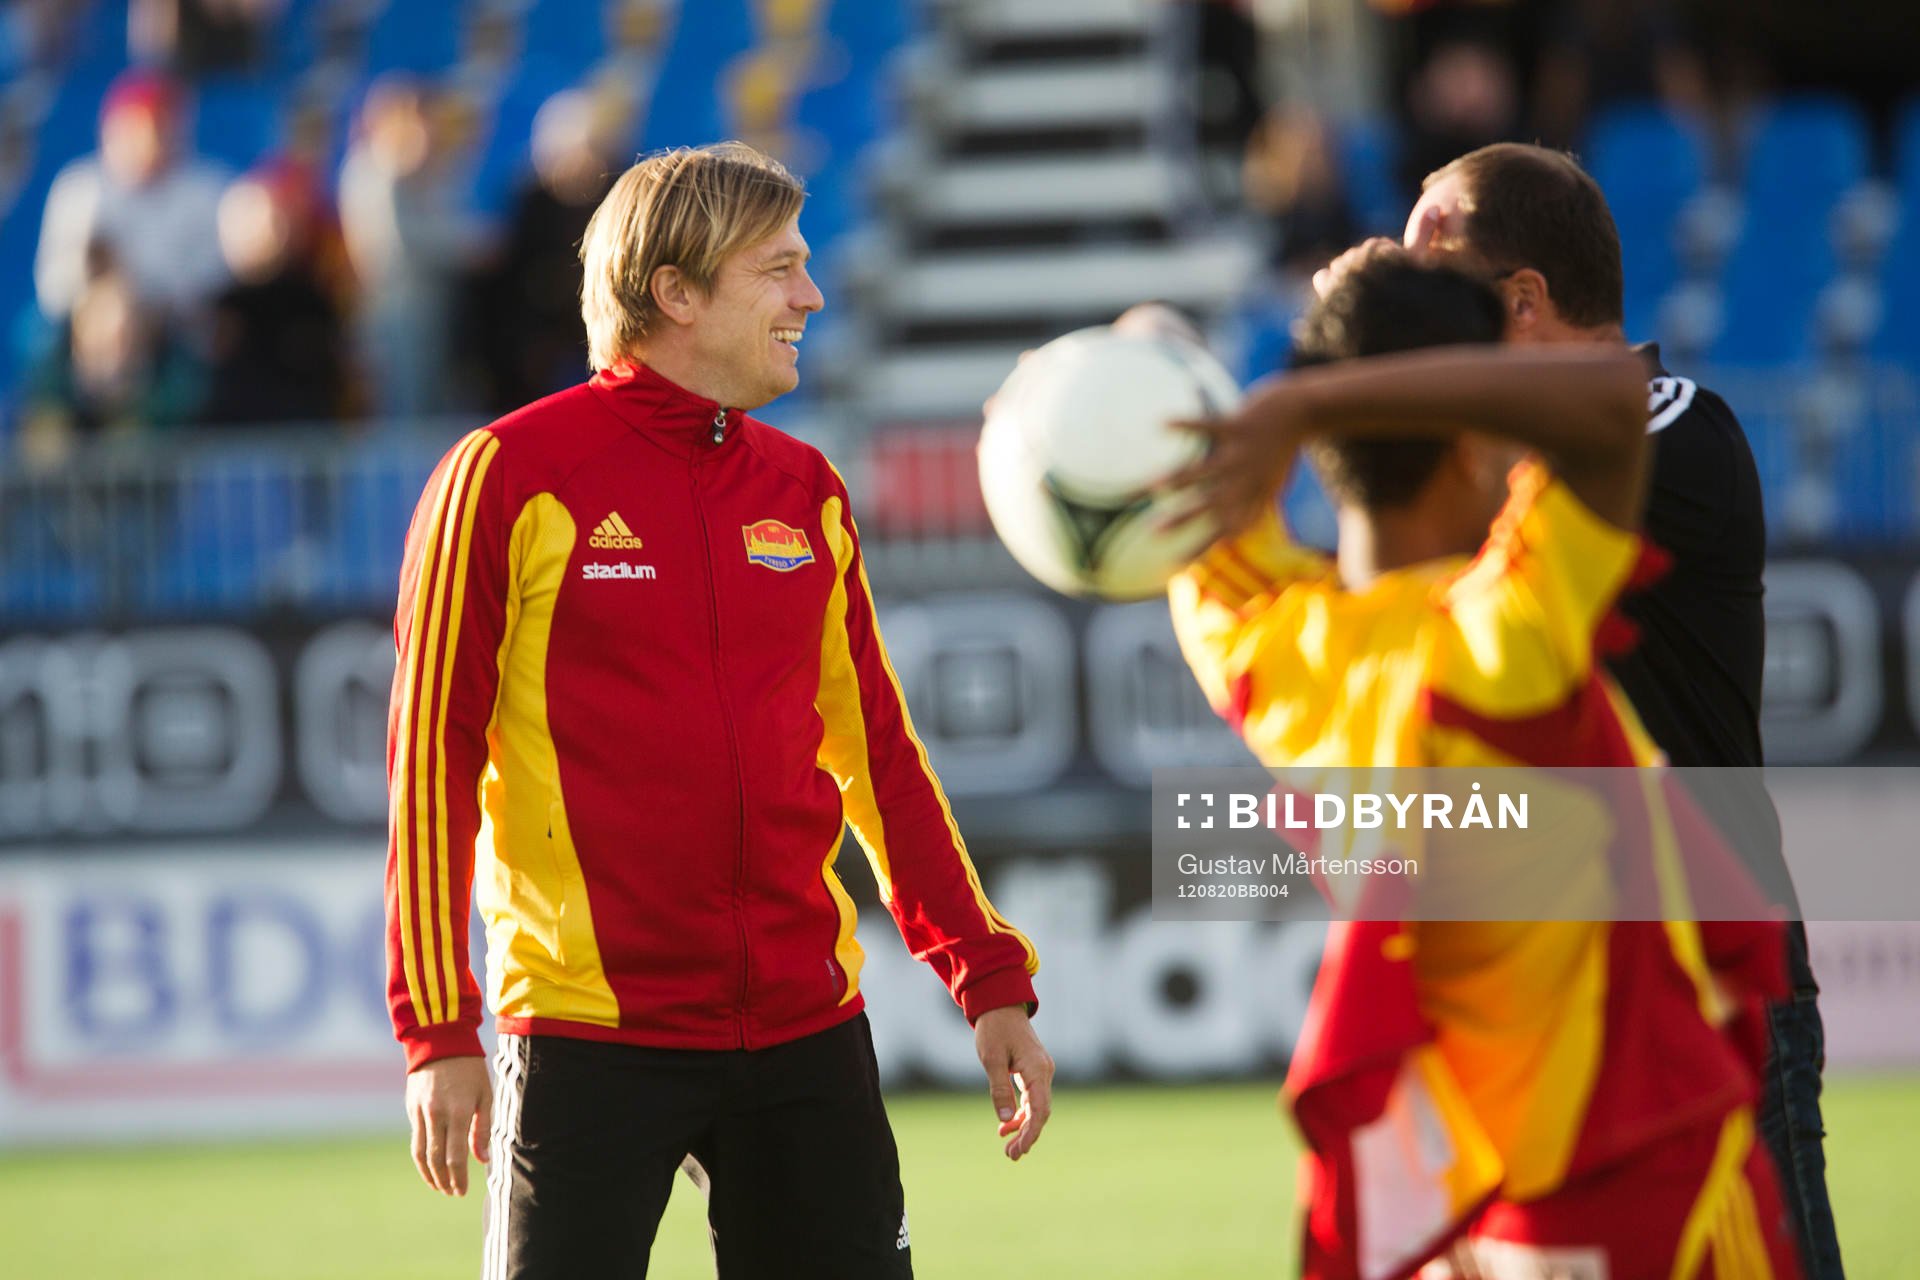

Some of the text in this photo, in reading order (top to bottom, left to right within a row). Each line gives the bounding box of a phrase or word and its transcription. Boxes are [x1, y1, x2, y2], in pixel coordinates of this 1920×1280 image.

[589, 534, 643, 549] adidas
[582, 561, 657, 579] stadium
[64, 894, 389, 1044] BD
